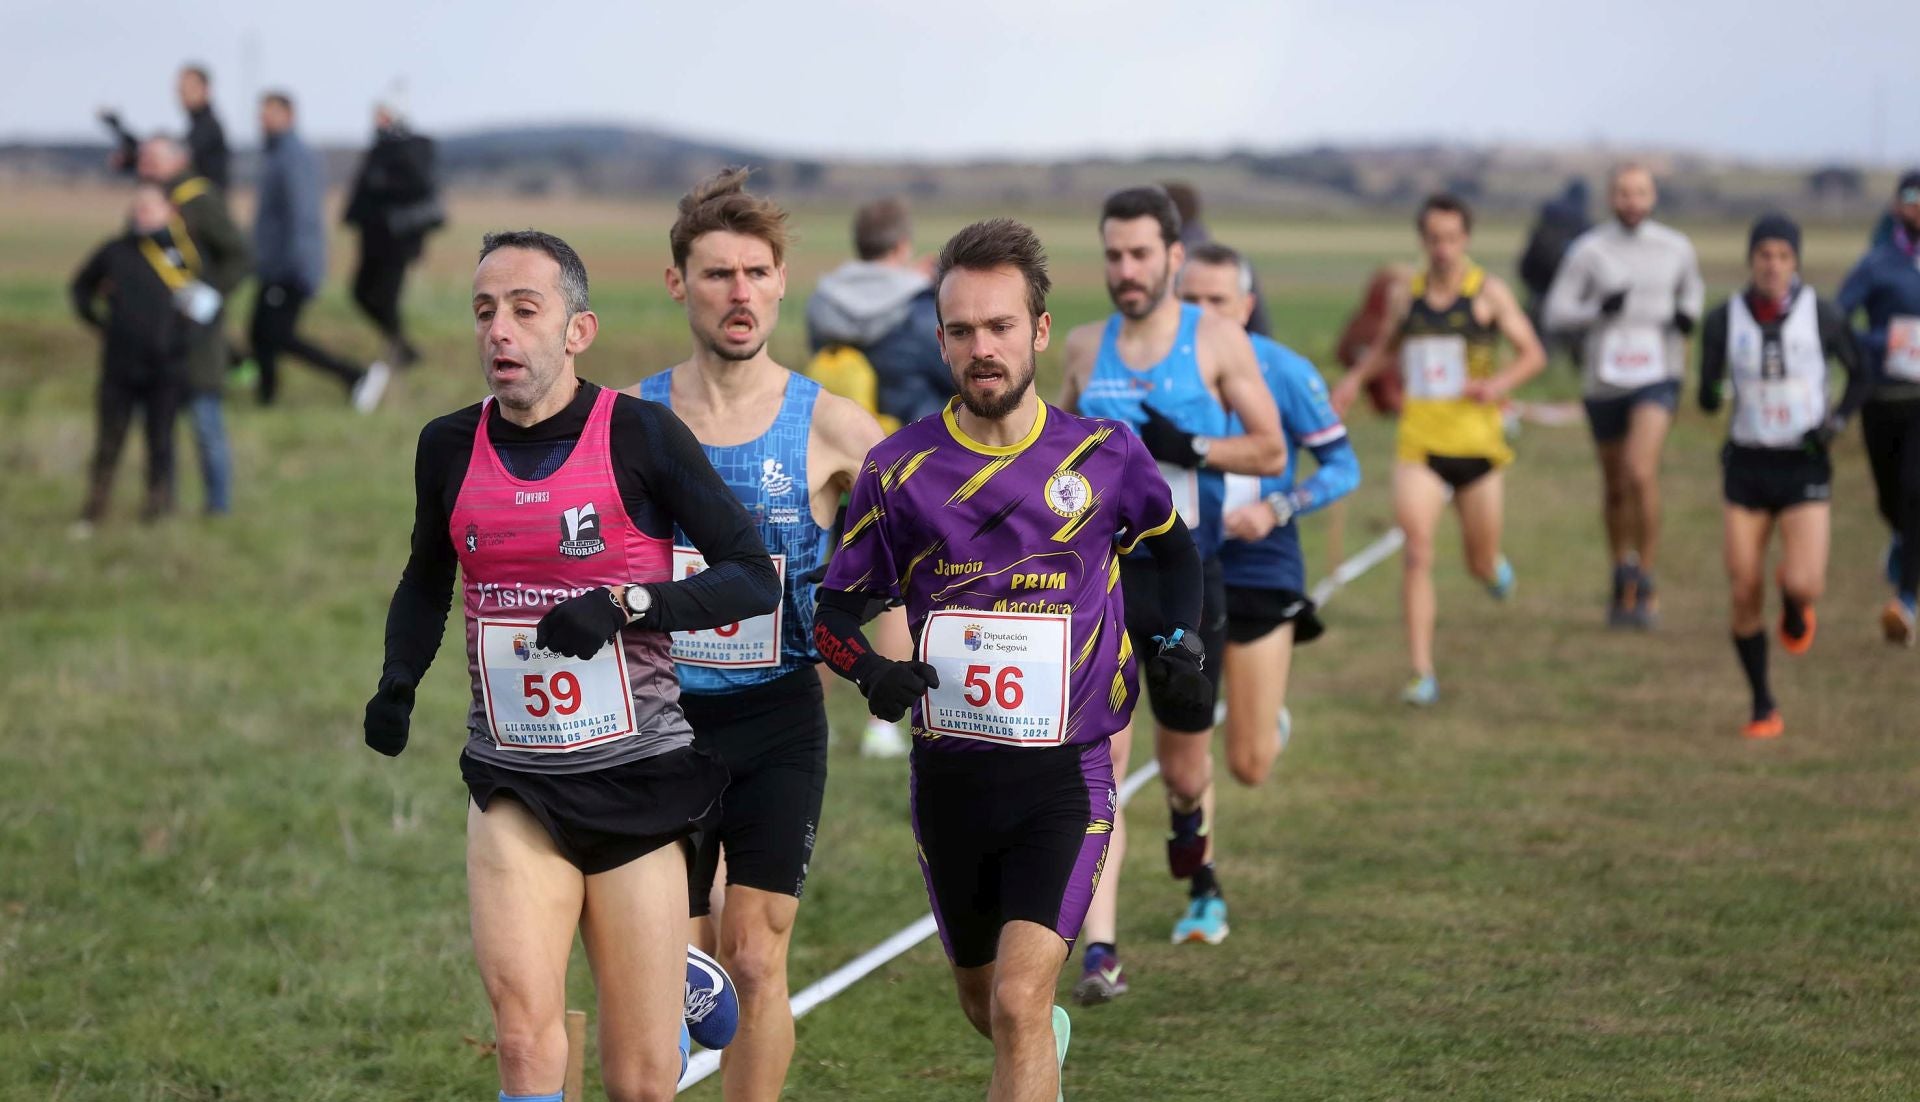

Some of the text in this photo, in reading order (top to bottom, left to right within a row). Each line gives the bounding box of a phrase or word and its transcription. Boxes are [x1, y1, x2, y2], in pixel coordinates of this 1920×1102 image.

[768, 516, 800, 524] ZAMORA
[559, 543, 606, 556] FISIORAMA
[934, 559, 984, 577] Jamón
[1010, 572, 1068, 590] PRIM
[477, 582, 612, 610] Fisioram
[992, 598, 1073, 615] Macotera
[703, 642, 751, 650] NACIONAL
[983, 632, 1028, 642] Diputación
[531, 652, 541, 660] de
[671, 648, 763, 661] NTIMPALOS 2024
[983, 643, 1028, 652] de Segovia
[523, 671, 582, 718] 59
[963, 664, 1024, 710] 56
[505, 713, 616, 732] LII CROSS NACIONAL DE
[939, 708, 1050, 726] LII CROSS NACIONAL DE
[508, 724, 617, 744] CANTIMPALOS 2024
[940, 719, 1014, 737] CANTIMPALOS
[1022, 727, 1049, 738] 2024
